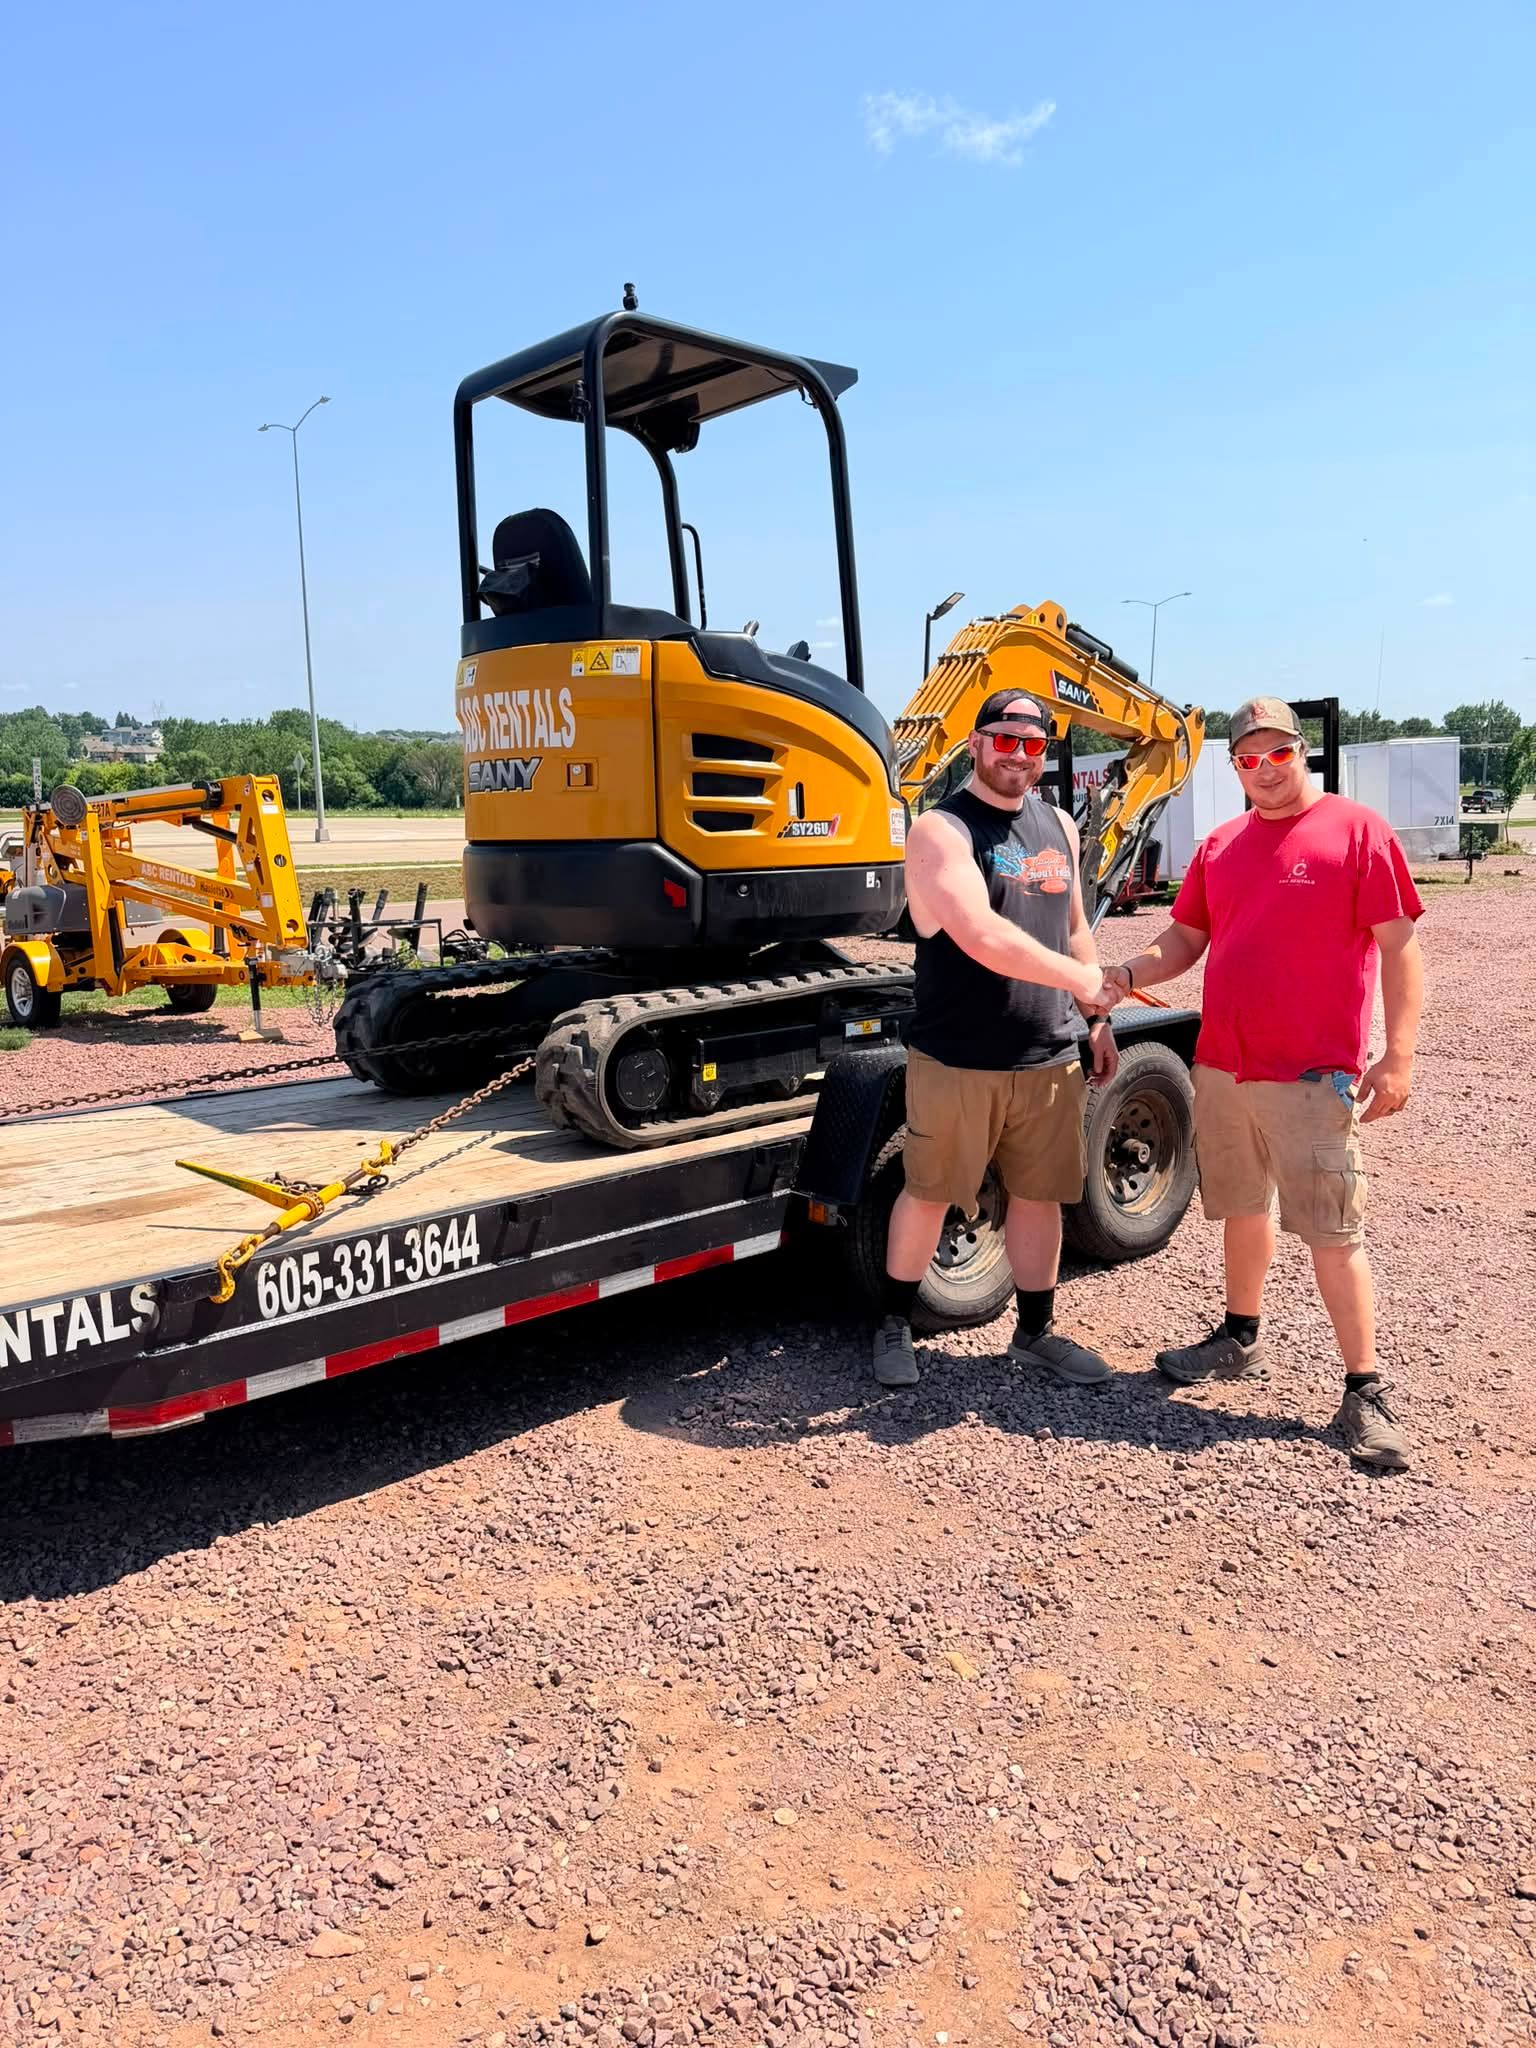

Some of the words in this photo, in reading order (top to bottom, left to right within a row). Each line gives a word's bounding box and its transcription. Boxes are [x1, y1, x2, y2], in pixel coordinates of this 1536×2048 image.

[1058, 679, 1090, 704] SANY
[483, 687, 576, 750] RENTALS
[468, 757, 543, 793] SANY
[791, 822, 829, 836] SY26U
[1434, 815, 1454, 826] 7X14
[141, 863, 158, 877] ABC
[160, 866, 197, 888] RENTALS
[257, 1213, 480, 1319] 605-331-3644
[0, 1283, 160, 1368] NTALS
